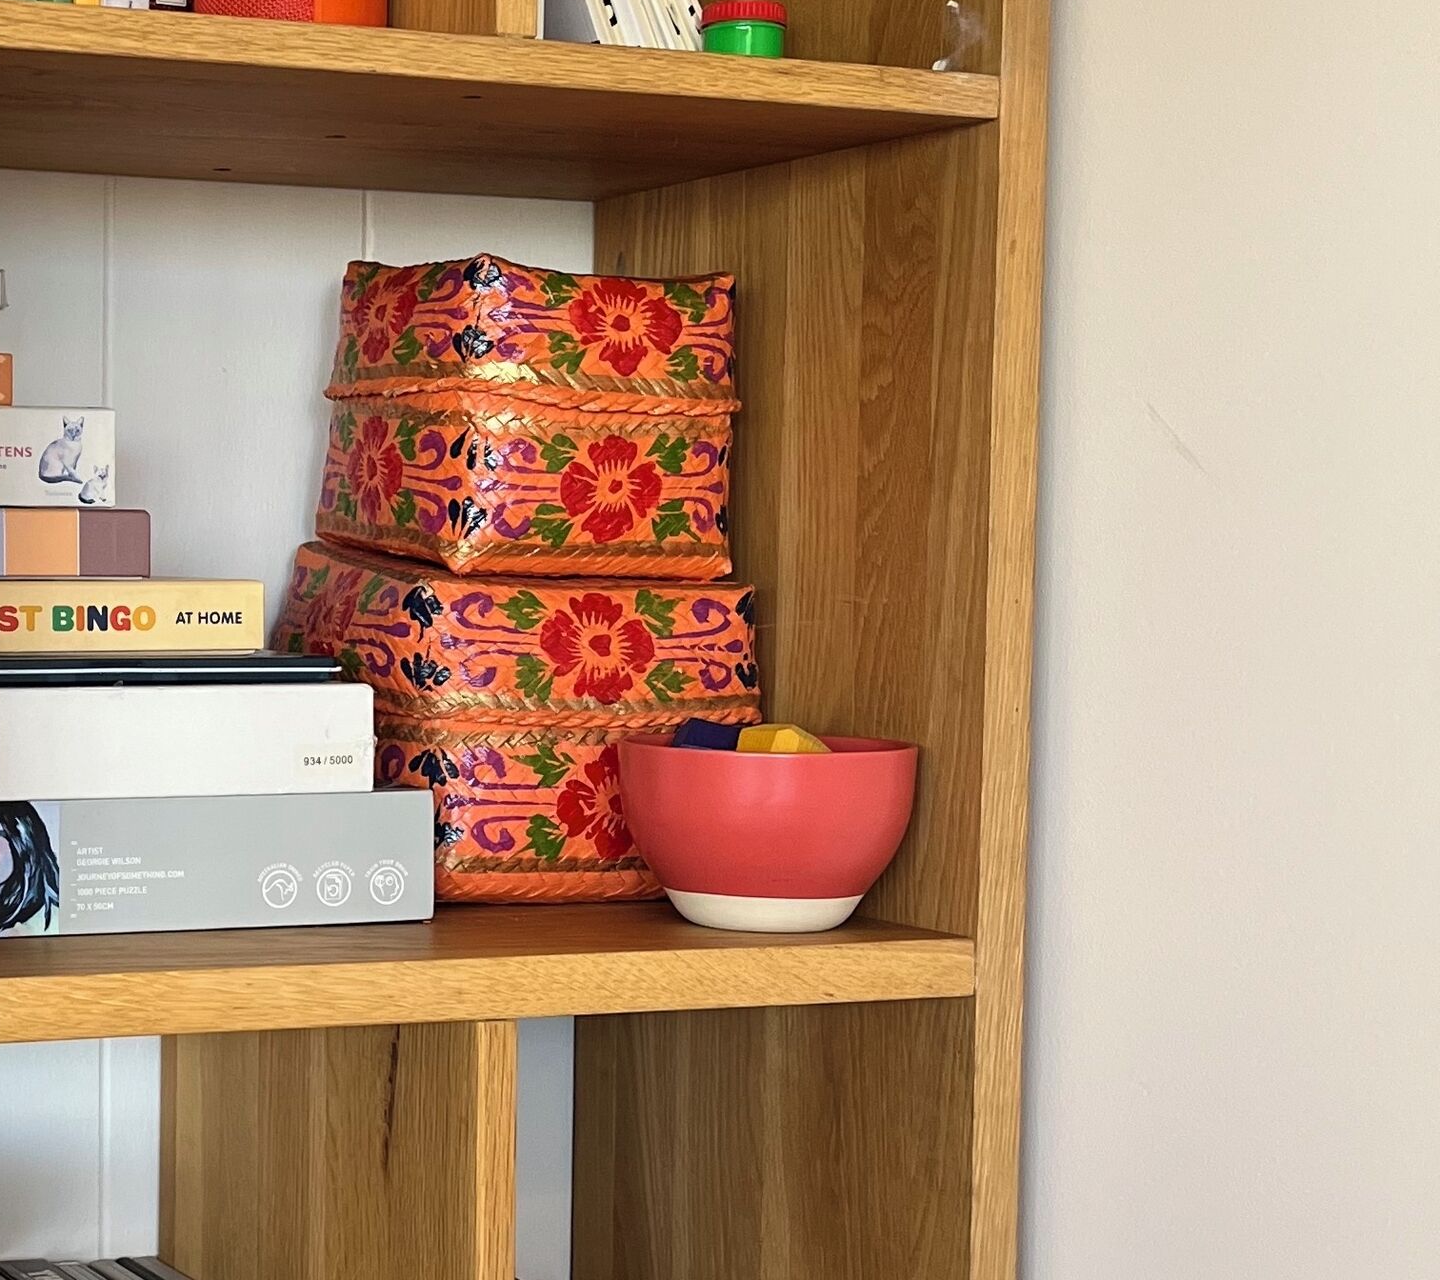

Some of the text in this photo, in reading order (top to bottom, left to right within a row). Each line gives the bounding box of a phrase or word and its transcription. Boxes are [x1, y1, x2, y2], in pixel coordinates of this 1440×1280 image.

[52, 605, 157, 632] BINGO
[175, 611, 193, 625] AT
[197, 611, 243, 625] HOME
[303, 754, 354, 766] 934 5000
[76, 846, 104, 856] ARTIST
[111, 856, 142, 866] WILSON
[94, 885, 148, 896] PIECE PUZZLE
